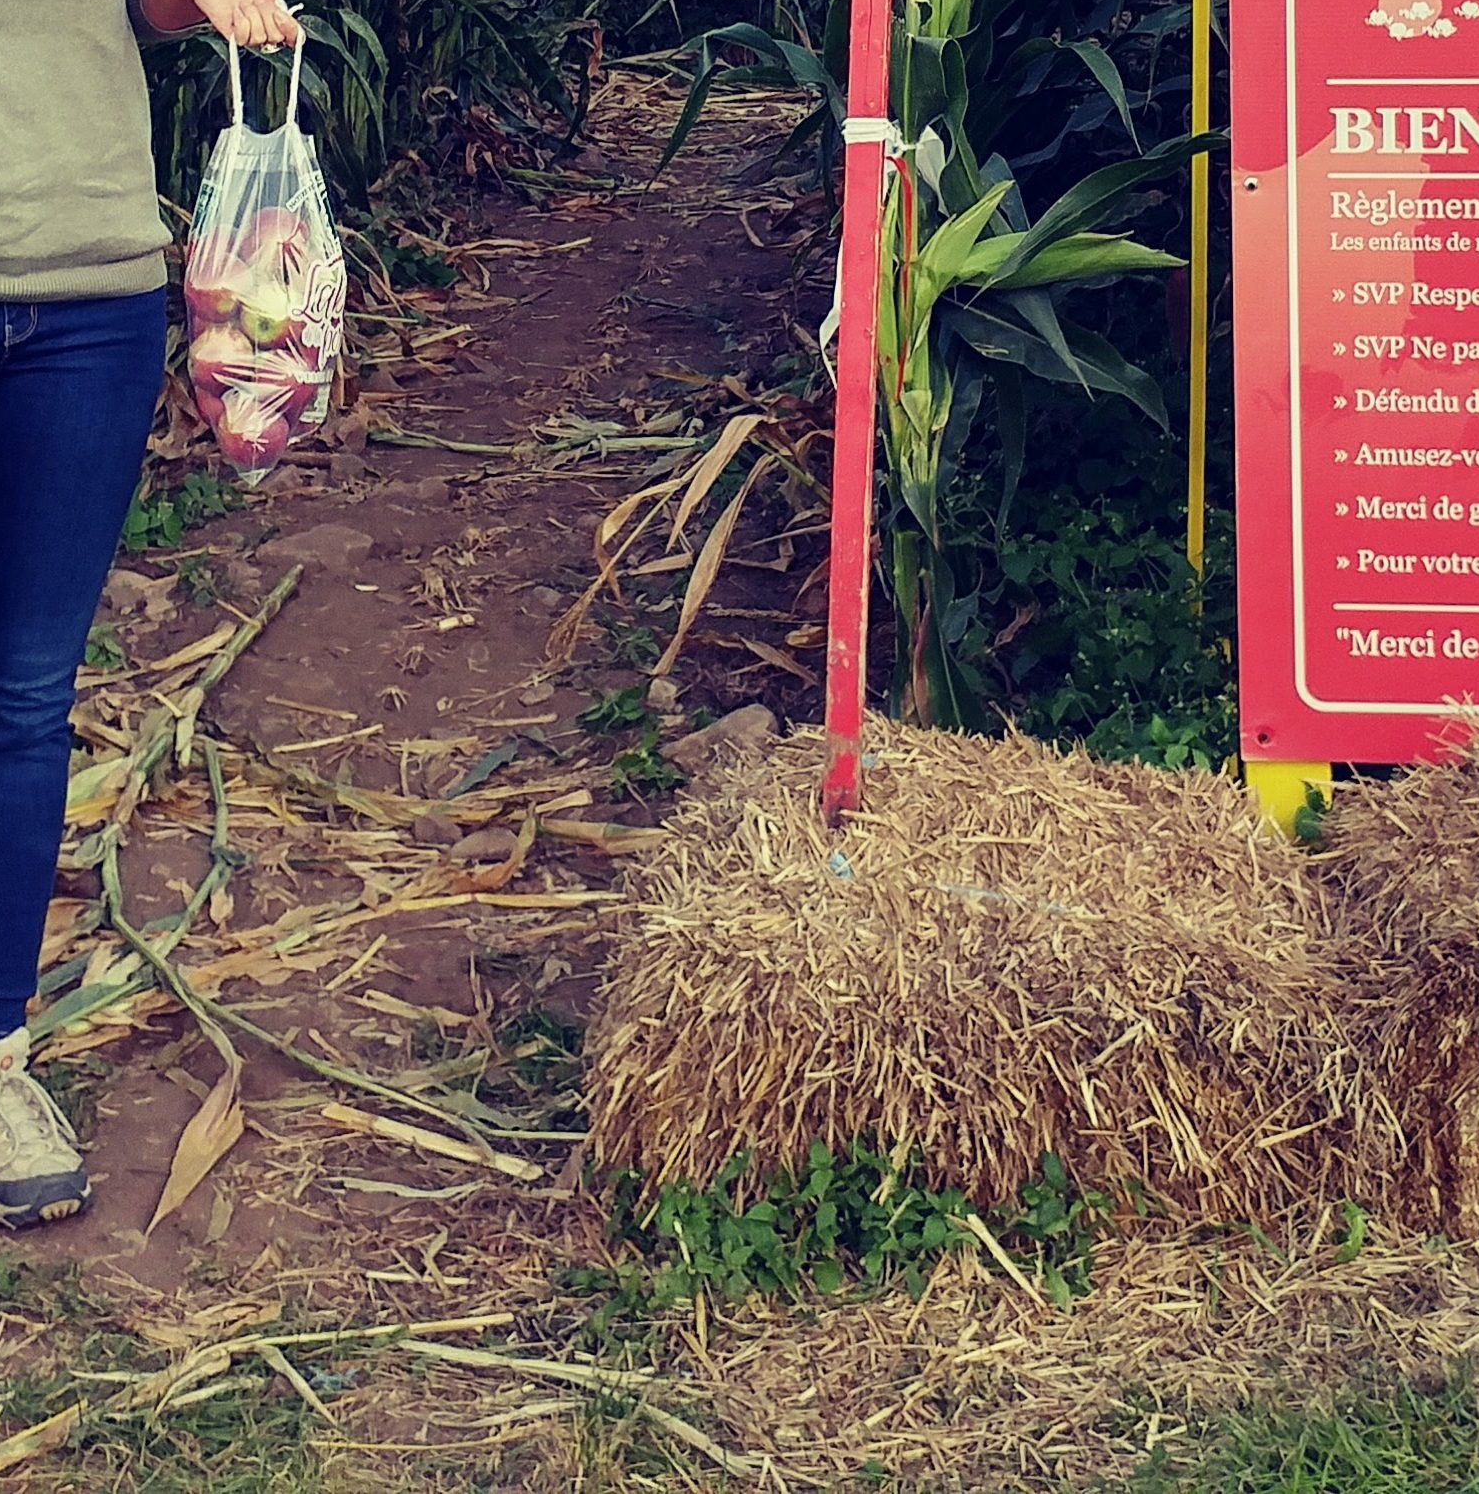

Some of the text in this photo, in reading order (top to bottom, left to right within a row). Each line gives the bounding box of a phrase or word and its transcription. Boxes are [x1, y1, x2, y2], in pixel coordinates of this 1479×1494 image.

[1330, 232, 1365, 251] Les
[1368, 231, 1443, 252] enfants
[1445, 231, 1472, 252] de
[1353, 281, 1405, 305] SVP
[1353, 335, 1406, 359] SVP
[1410, 335, 1448, 360] Ne
[1354, 387, 1461, 414] Défendu
[1355, 495, 1429, 520] Merci
[1432, 494, 1465, 521] de
[1356, 548, 1418, 574] Pour
